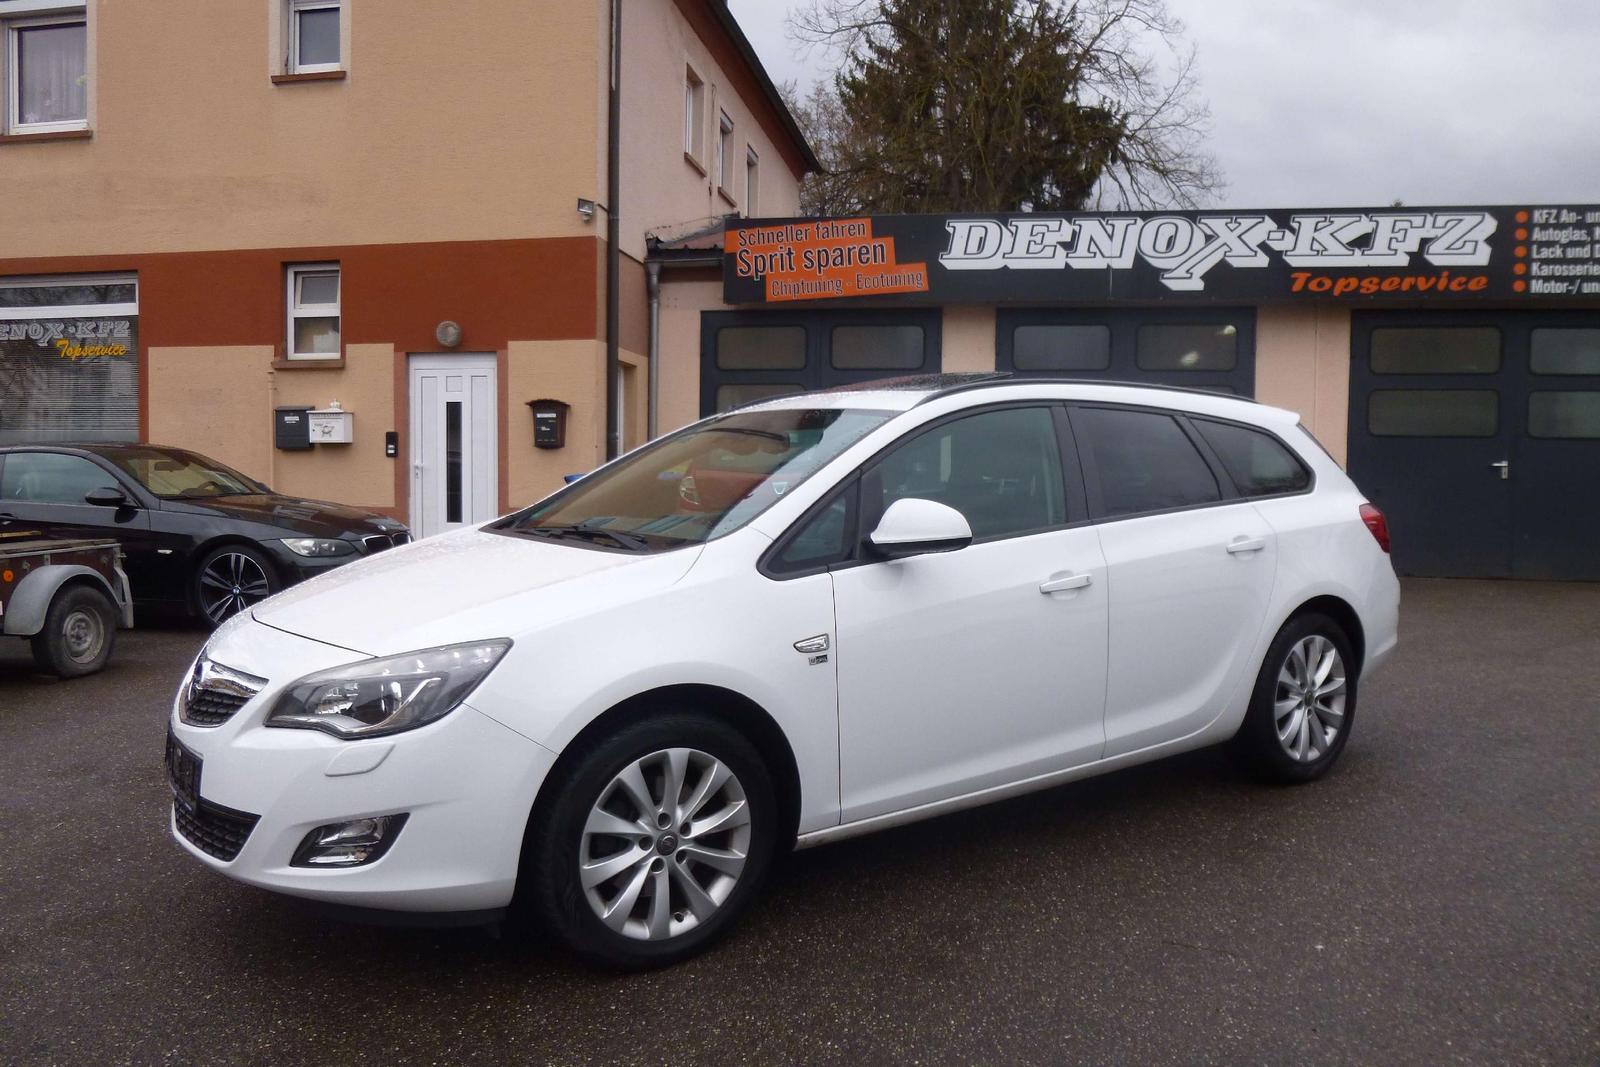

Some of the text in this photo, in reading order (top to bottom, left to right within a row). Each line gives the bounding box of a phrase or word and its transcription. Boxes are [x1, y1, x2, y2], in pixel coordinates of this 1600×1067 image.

[1533, 209, 1558, 223] KFZ
[738, 221, 866, 247] Schneller fahren
[737, 241, 886, 281] Sprit sparen
[938, 211, 1498, 291] DENOX-KFZ
[1532, 244, 1563, 258] Lack
[1565, 244, 1591, 258] und
[771, 271, 924, 299] Chiptuning Ecotuning
[1290, 271, 1488, 297] Topservice
[55, 338, 127, 361] Topservice
